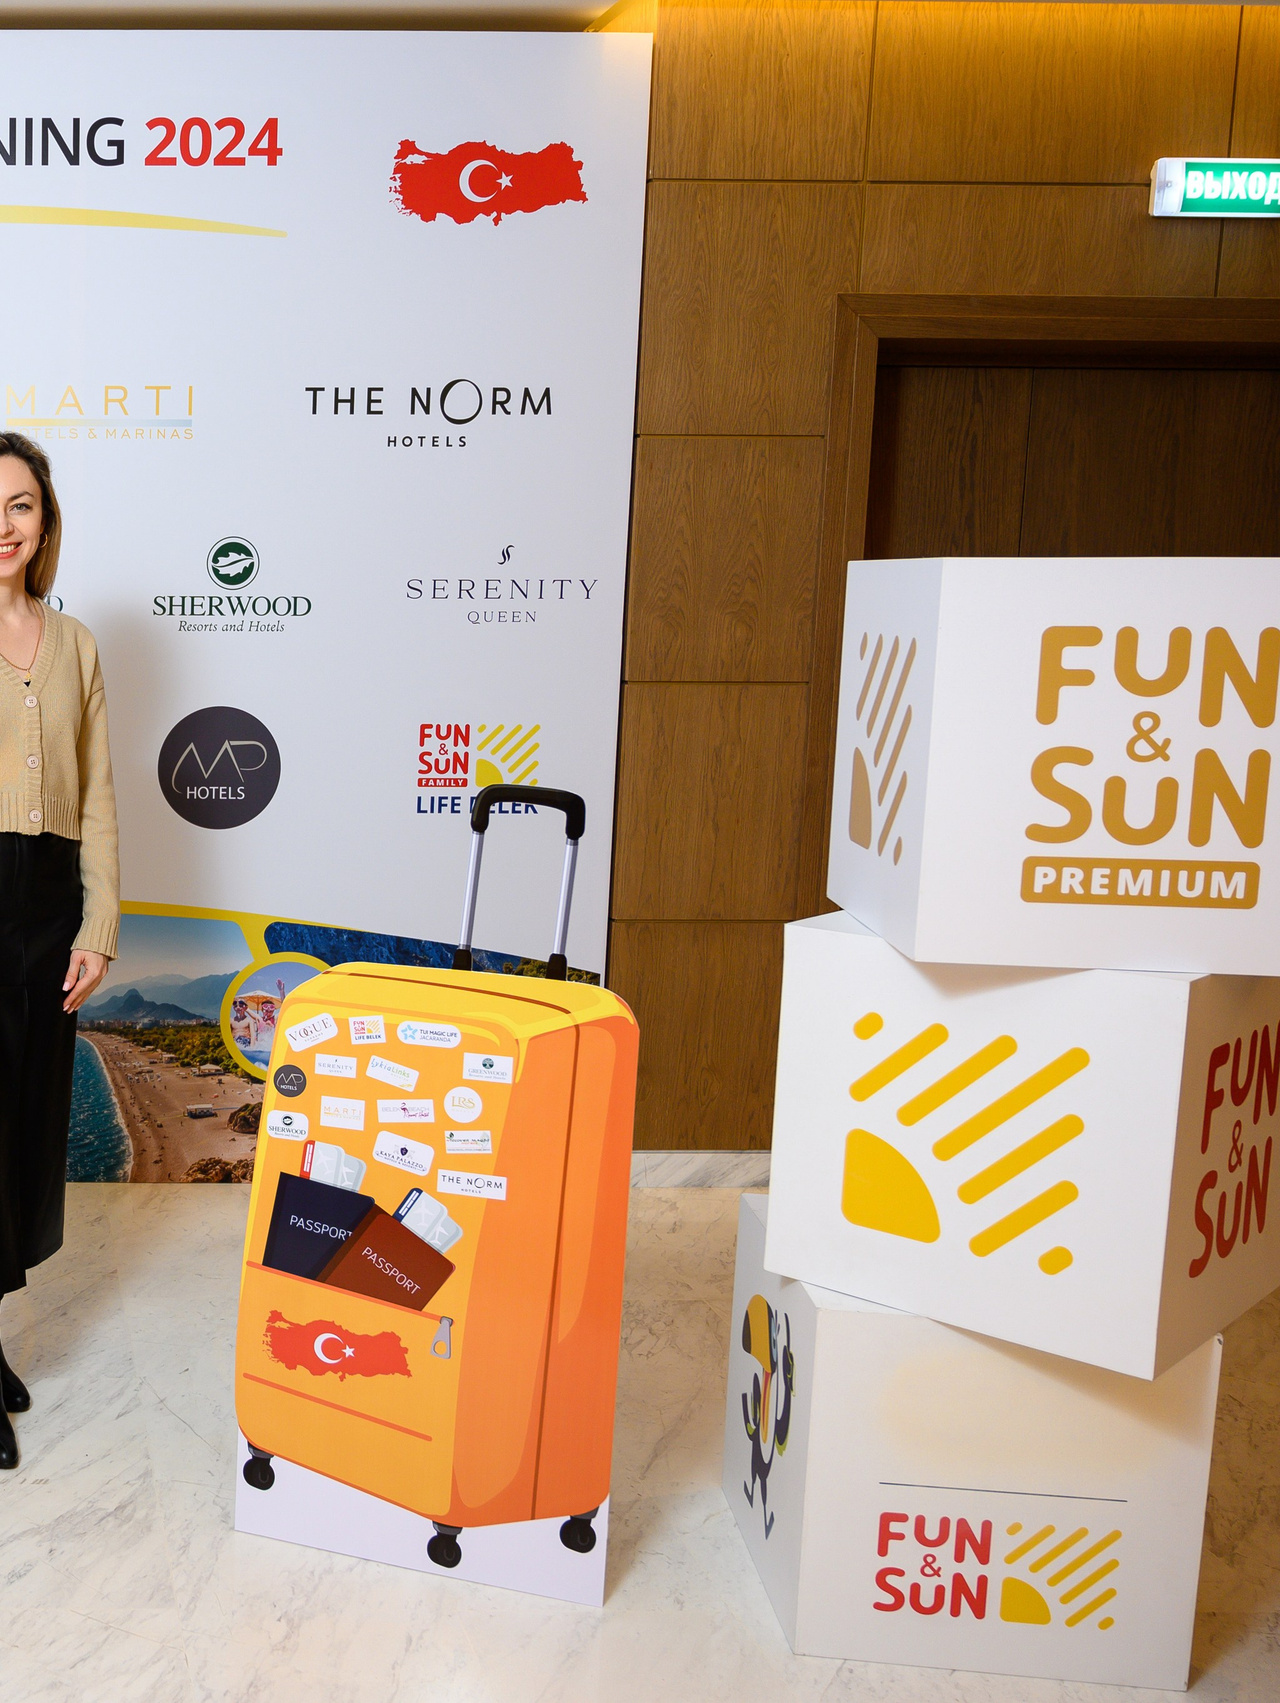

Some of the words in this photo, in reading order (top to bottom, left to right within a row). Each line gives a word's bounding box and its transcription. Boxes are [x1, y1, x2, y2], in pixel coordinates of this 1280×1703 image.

[144, 116, 283, 167] 2024
[1185, 170, 1280, 205] ВЫХОД
[6, 384, 193, 416] MARTI
[305, 387, 384, 416] THE
[411, 378, 552, 425] NORM
[87, 428, 98, 439] &
[105, 428, 194, 440] MARINAS
[387, 435, 468, 447] HOTELS
[406, 578, 598, 600] SERENITY
[152, 595, 312, 617] SHERWOOD
[177, 620, 218, 633] Resorts
[221, 620, 244, 632] and
[248, 620, 285, 632] Hotels
[467, 610, 538, 625] QUEEN
[1035, 625, 1280, 728] FUN
[419, 723, 471, 747] FUN
[1126, 710, 1172, 763] &
[438, 743, 449, 756] &
[418, 751, 469, 775] SUN
[186, 786, 246, 800] HOTELS
[422, 779, 464, 787] FAMILY
[416, 796, 462, 814] LIFE
[1024, 745, 1272, 849] SUN
[1033, 866, 1247, 900] PREMIUM
[289, 1018, 332, 1041] VOGUE
[420, 1034, 451, 1042] JACARANDA
[318, 1062, 353, 1070] SERENITY
[468, 1068, 507, 1076] GREENWOOD
[1201, 1018, 1280, 1155] FUN
[323, 1106, 361, 1116] MARTI
[451, 1096, 475, 1109] LRS
[268, 1125, 307, 1135] SHERWOOD
[1228, 1119, 1244, 1174] &
[396, 1156, 424, 1169] PALAZZO
[441, 1174, 461, 1184] THE
[467, 1177, 503, 1189] NORM
[1188, 1135, 1273, 1278] SUN
[361, 1246, 421, 1295] PASSPORT
[876, 1511, 993, 1566] FUN
[920, 1553, 942, 1578] &
[873, 1566, 988, 1620] SUN
